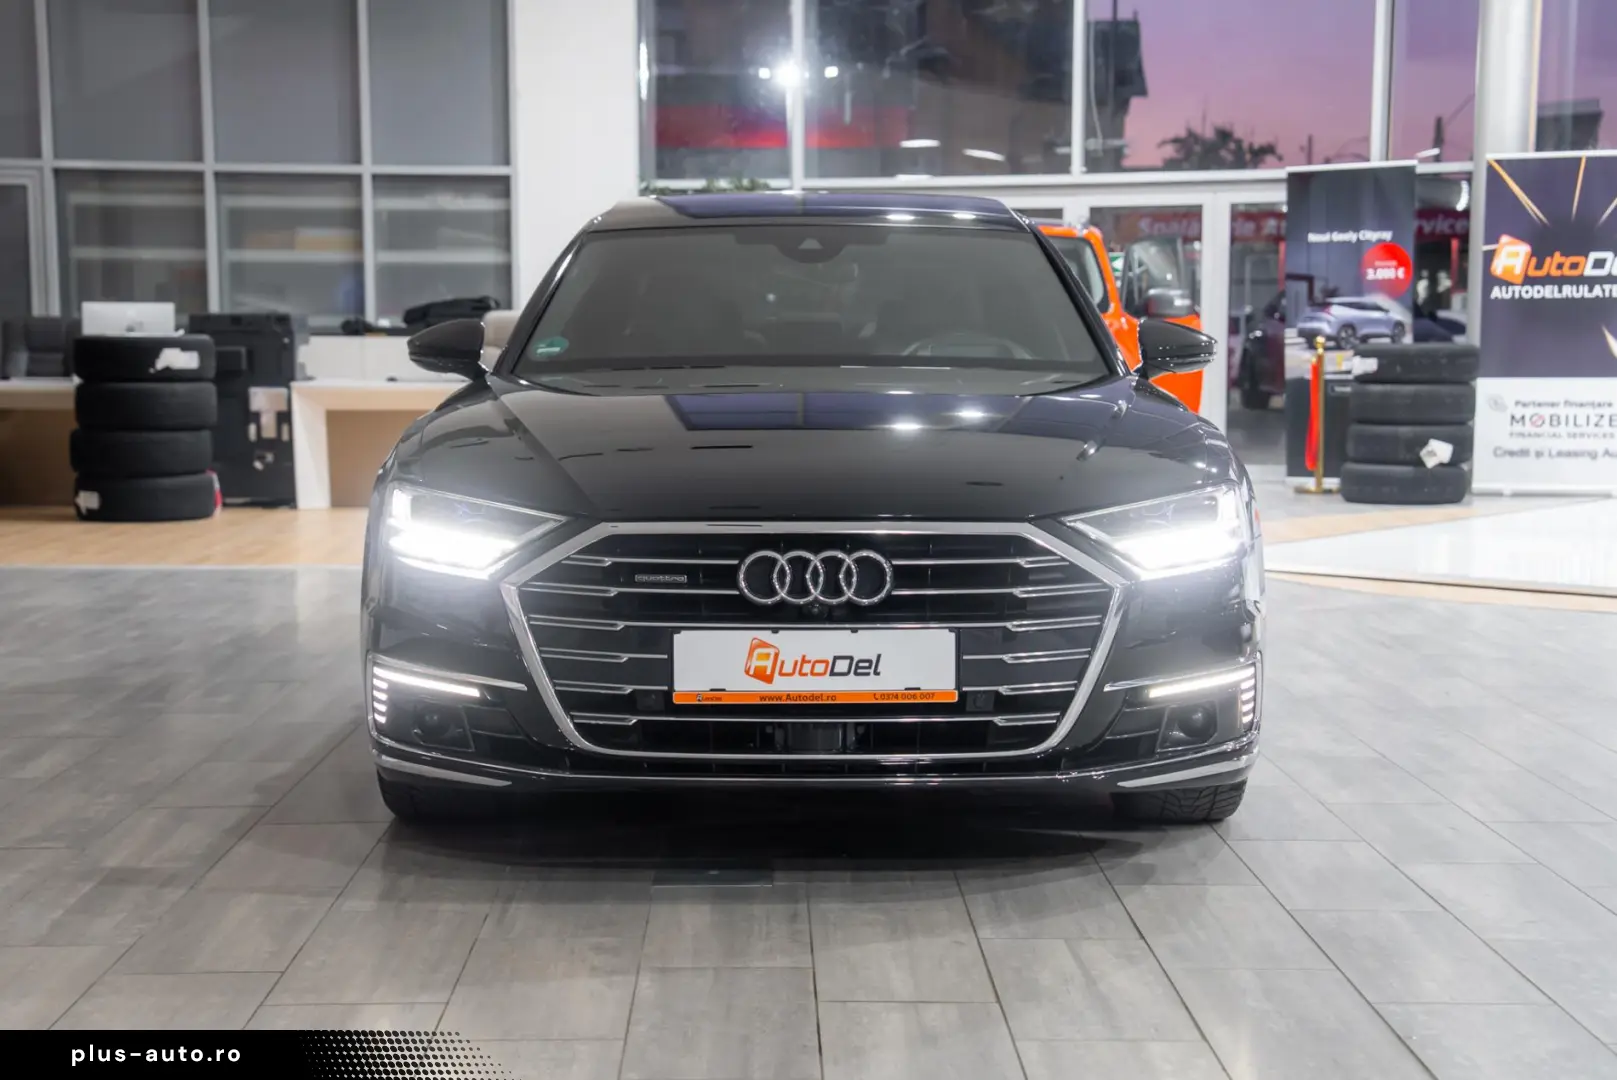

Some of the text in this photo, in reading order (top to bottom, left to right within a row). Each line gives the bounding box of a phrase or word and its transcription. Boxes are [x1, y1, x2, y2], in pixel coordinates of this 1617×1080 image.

[1514, 399, 1560, 408] Partener
[1493, 446, 1530, 458] Credit
[1548, 447, 1598, 461] Leasing
[745, 641, 881, 681] AutoDel
[759, 693, 837, 702] www.Autodel.ro
